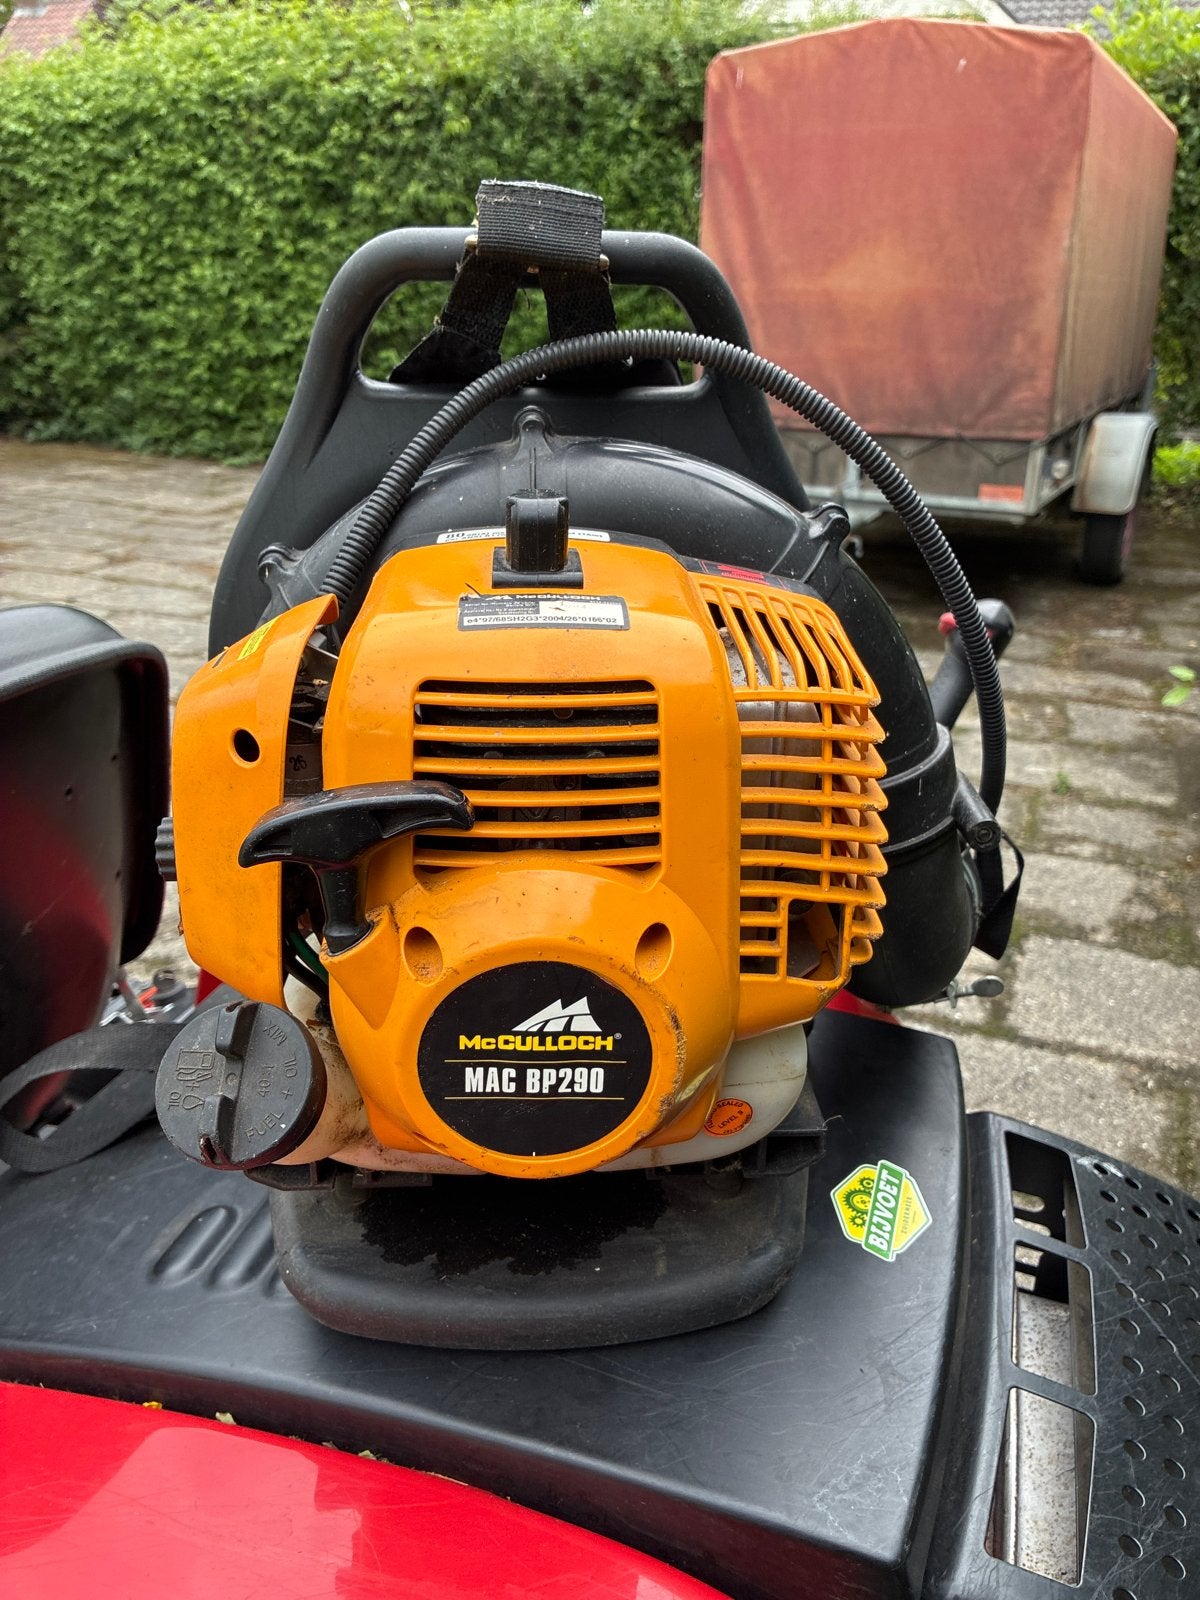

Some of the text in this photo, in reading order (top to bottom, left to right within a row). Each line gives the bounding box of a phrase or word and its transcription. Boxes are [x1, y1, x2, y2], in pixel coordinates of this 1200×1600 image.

[262, 1020, 288, 1047] MIX
[459, 1034, 613, 1052] McCULLOCH
[283, 1052, 298, 1079] OIL
[464, 1067, 605, 1094] MAC BP290
[168, 1090, 183, 1110] OIL
[245, 1111, 285, 1143] FUEL
[717, 1114, 739, 1129] LEVEL
[867, 1168, 901, 1251] BIJVOET
